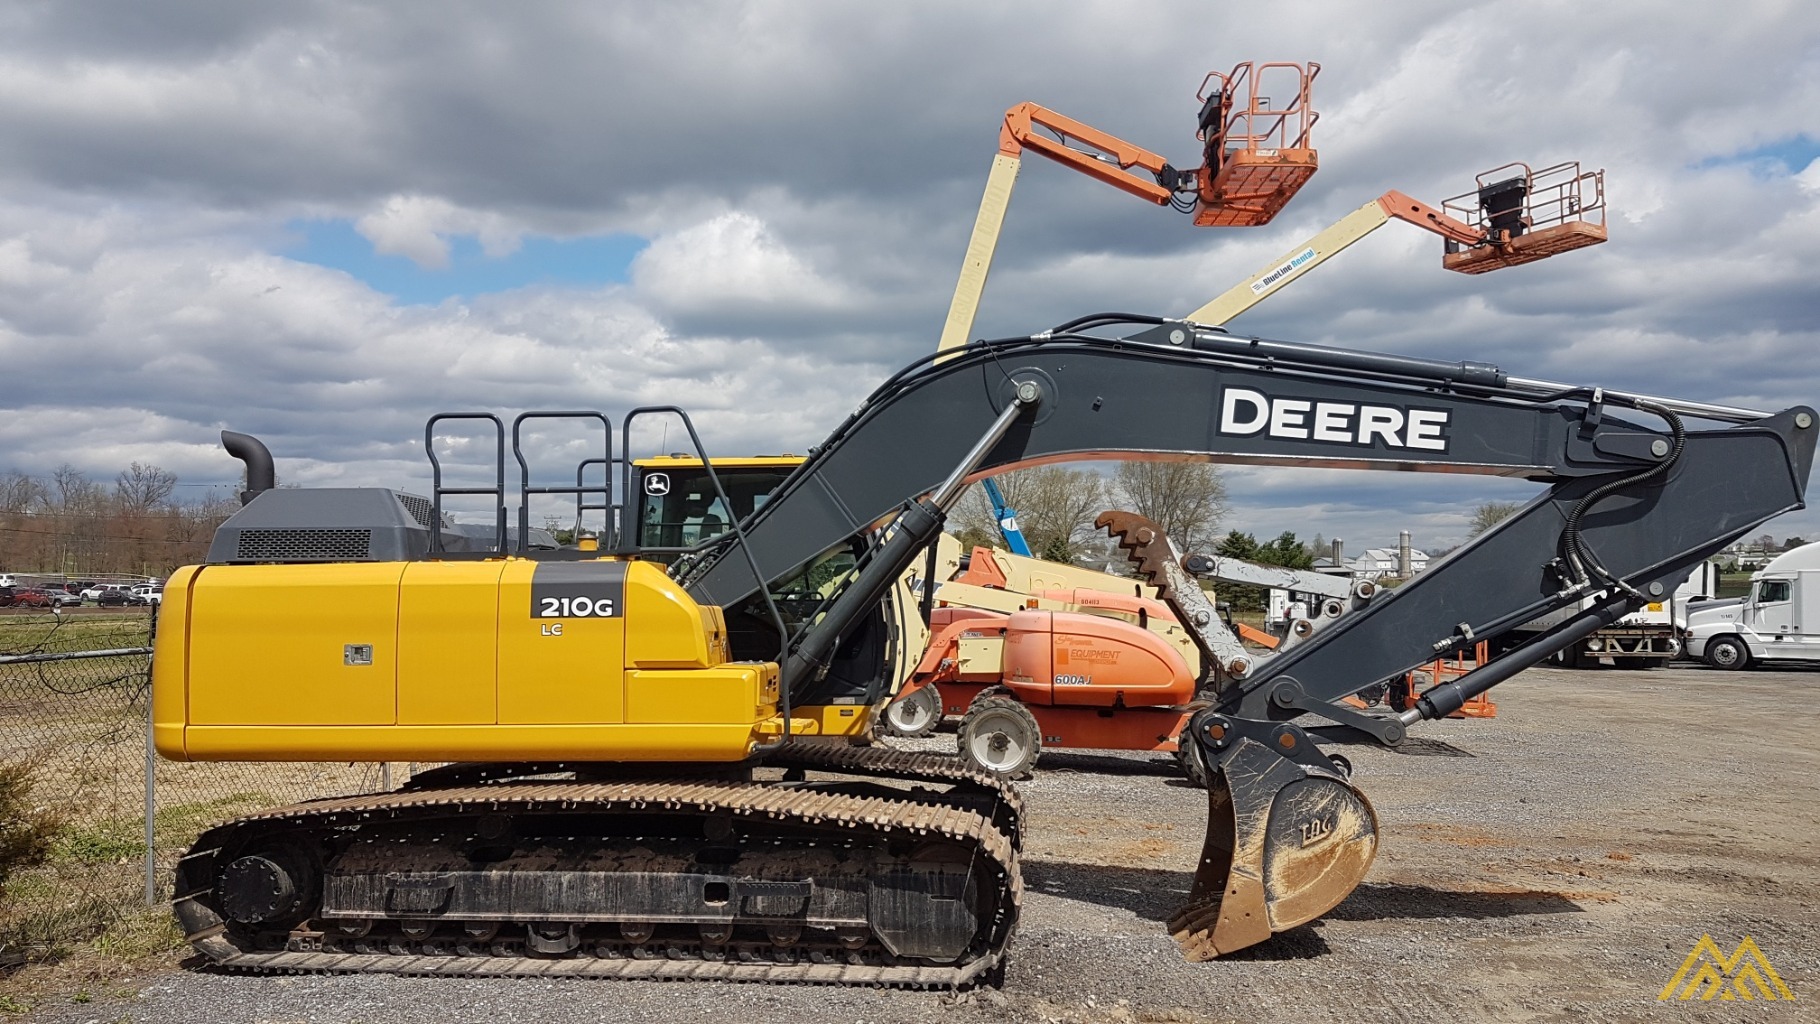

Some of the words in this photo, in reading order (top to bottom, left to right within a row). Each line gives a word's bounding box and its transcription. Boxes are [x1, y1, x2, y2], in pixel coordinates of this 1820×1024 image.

[1262, 264, 1293, 286] BlueLine
[1291, 249, 1315, 268] Rental
[1220, 387, 1448, 451] DEERE
[540, 596, 613, 617] 210G
[541, 623, 563, 636] LC
[1071, 649, 1122, 659] EQUIPMENT
[1054, 674, 1092, 686] 600AJ
